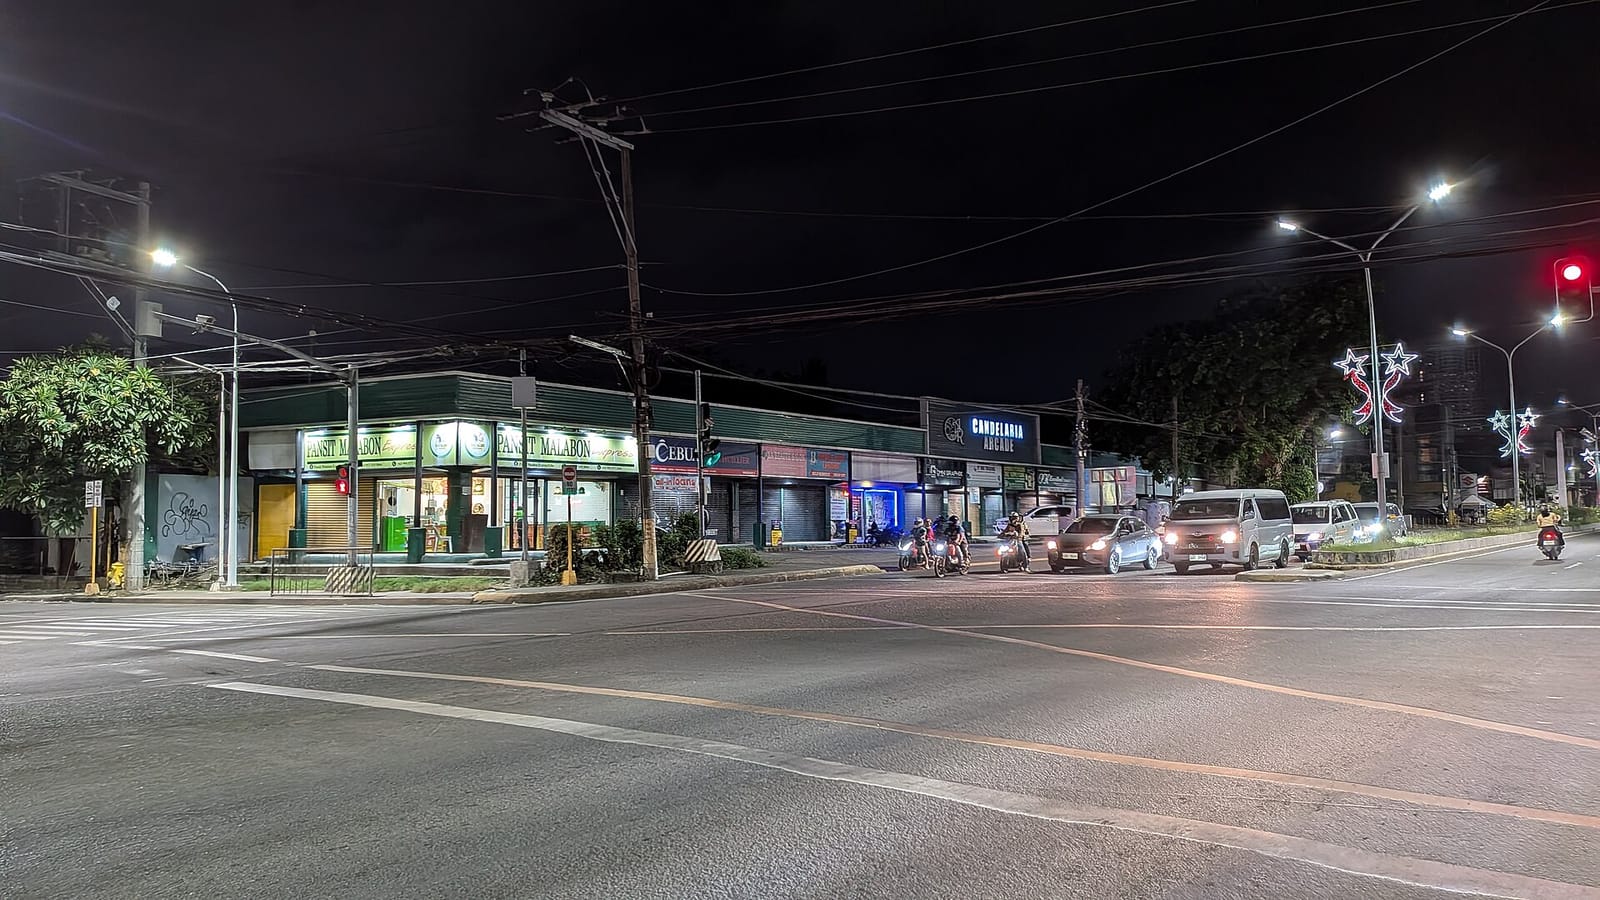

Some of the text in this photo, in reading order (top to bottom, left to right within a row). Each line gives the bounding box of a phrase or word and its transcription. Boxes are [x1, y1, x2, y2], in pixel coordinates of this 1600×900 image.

[972, 418, 1024, 439] CANDELARIA
[307, 439, 337, 458] PANSIT
[339, 437, 382, 456] MABON
[497, 433, 537, 454] PANST
[540, 437, 592, 458] MALABON
[984, 436, 1015, 453] ARCADE
